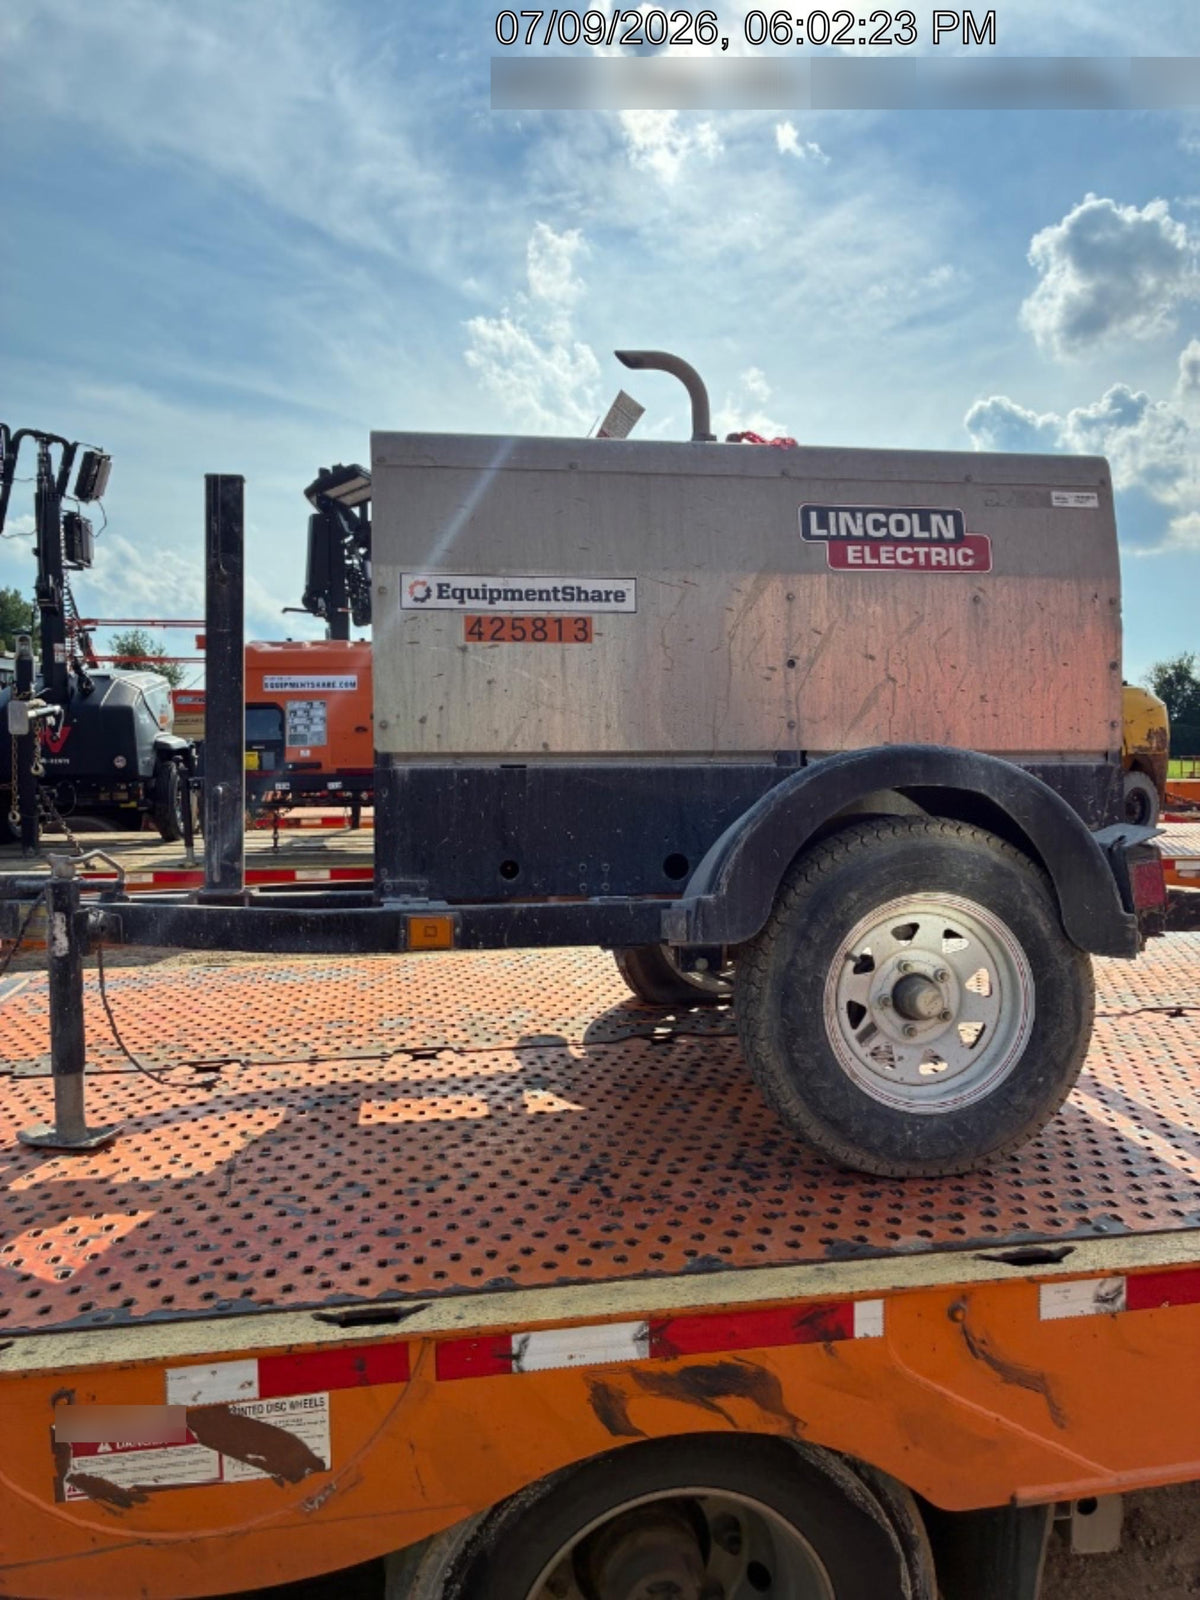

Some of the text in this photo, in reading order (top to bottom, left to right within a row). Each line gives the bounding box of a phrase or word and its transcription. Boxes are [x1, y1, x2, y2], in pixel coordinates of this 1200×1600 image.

[809, 511, 956, 540] LINCOLN
[847, 545, 975, 567] ELECTRIC
[436, 583, 627, 604] EquipmentShare
[468, 617, 589, 642] 425813
[266, 1402, 287, 1414] DISC
[289, 1397, 325, 1411] WHEELS
